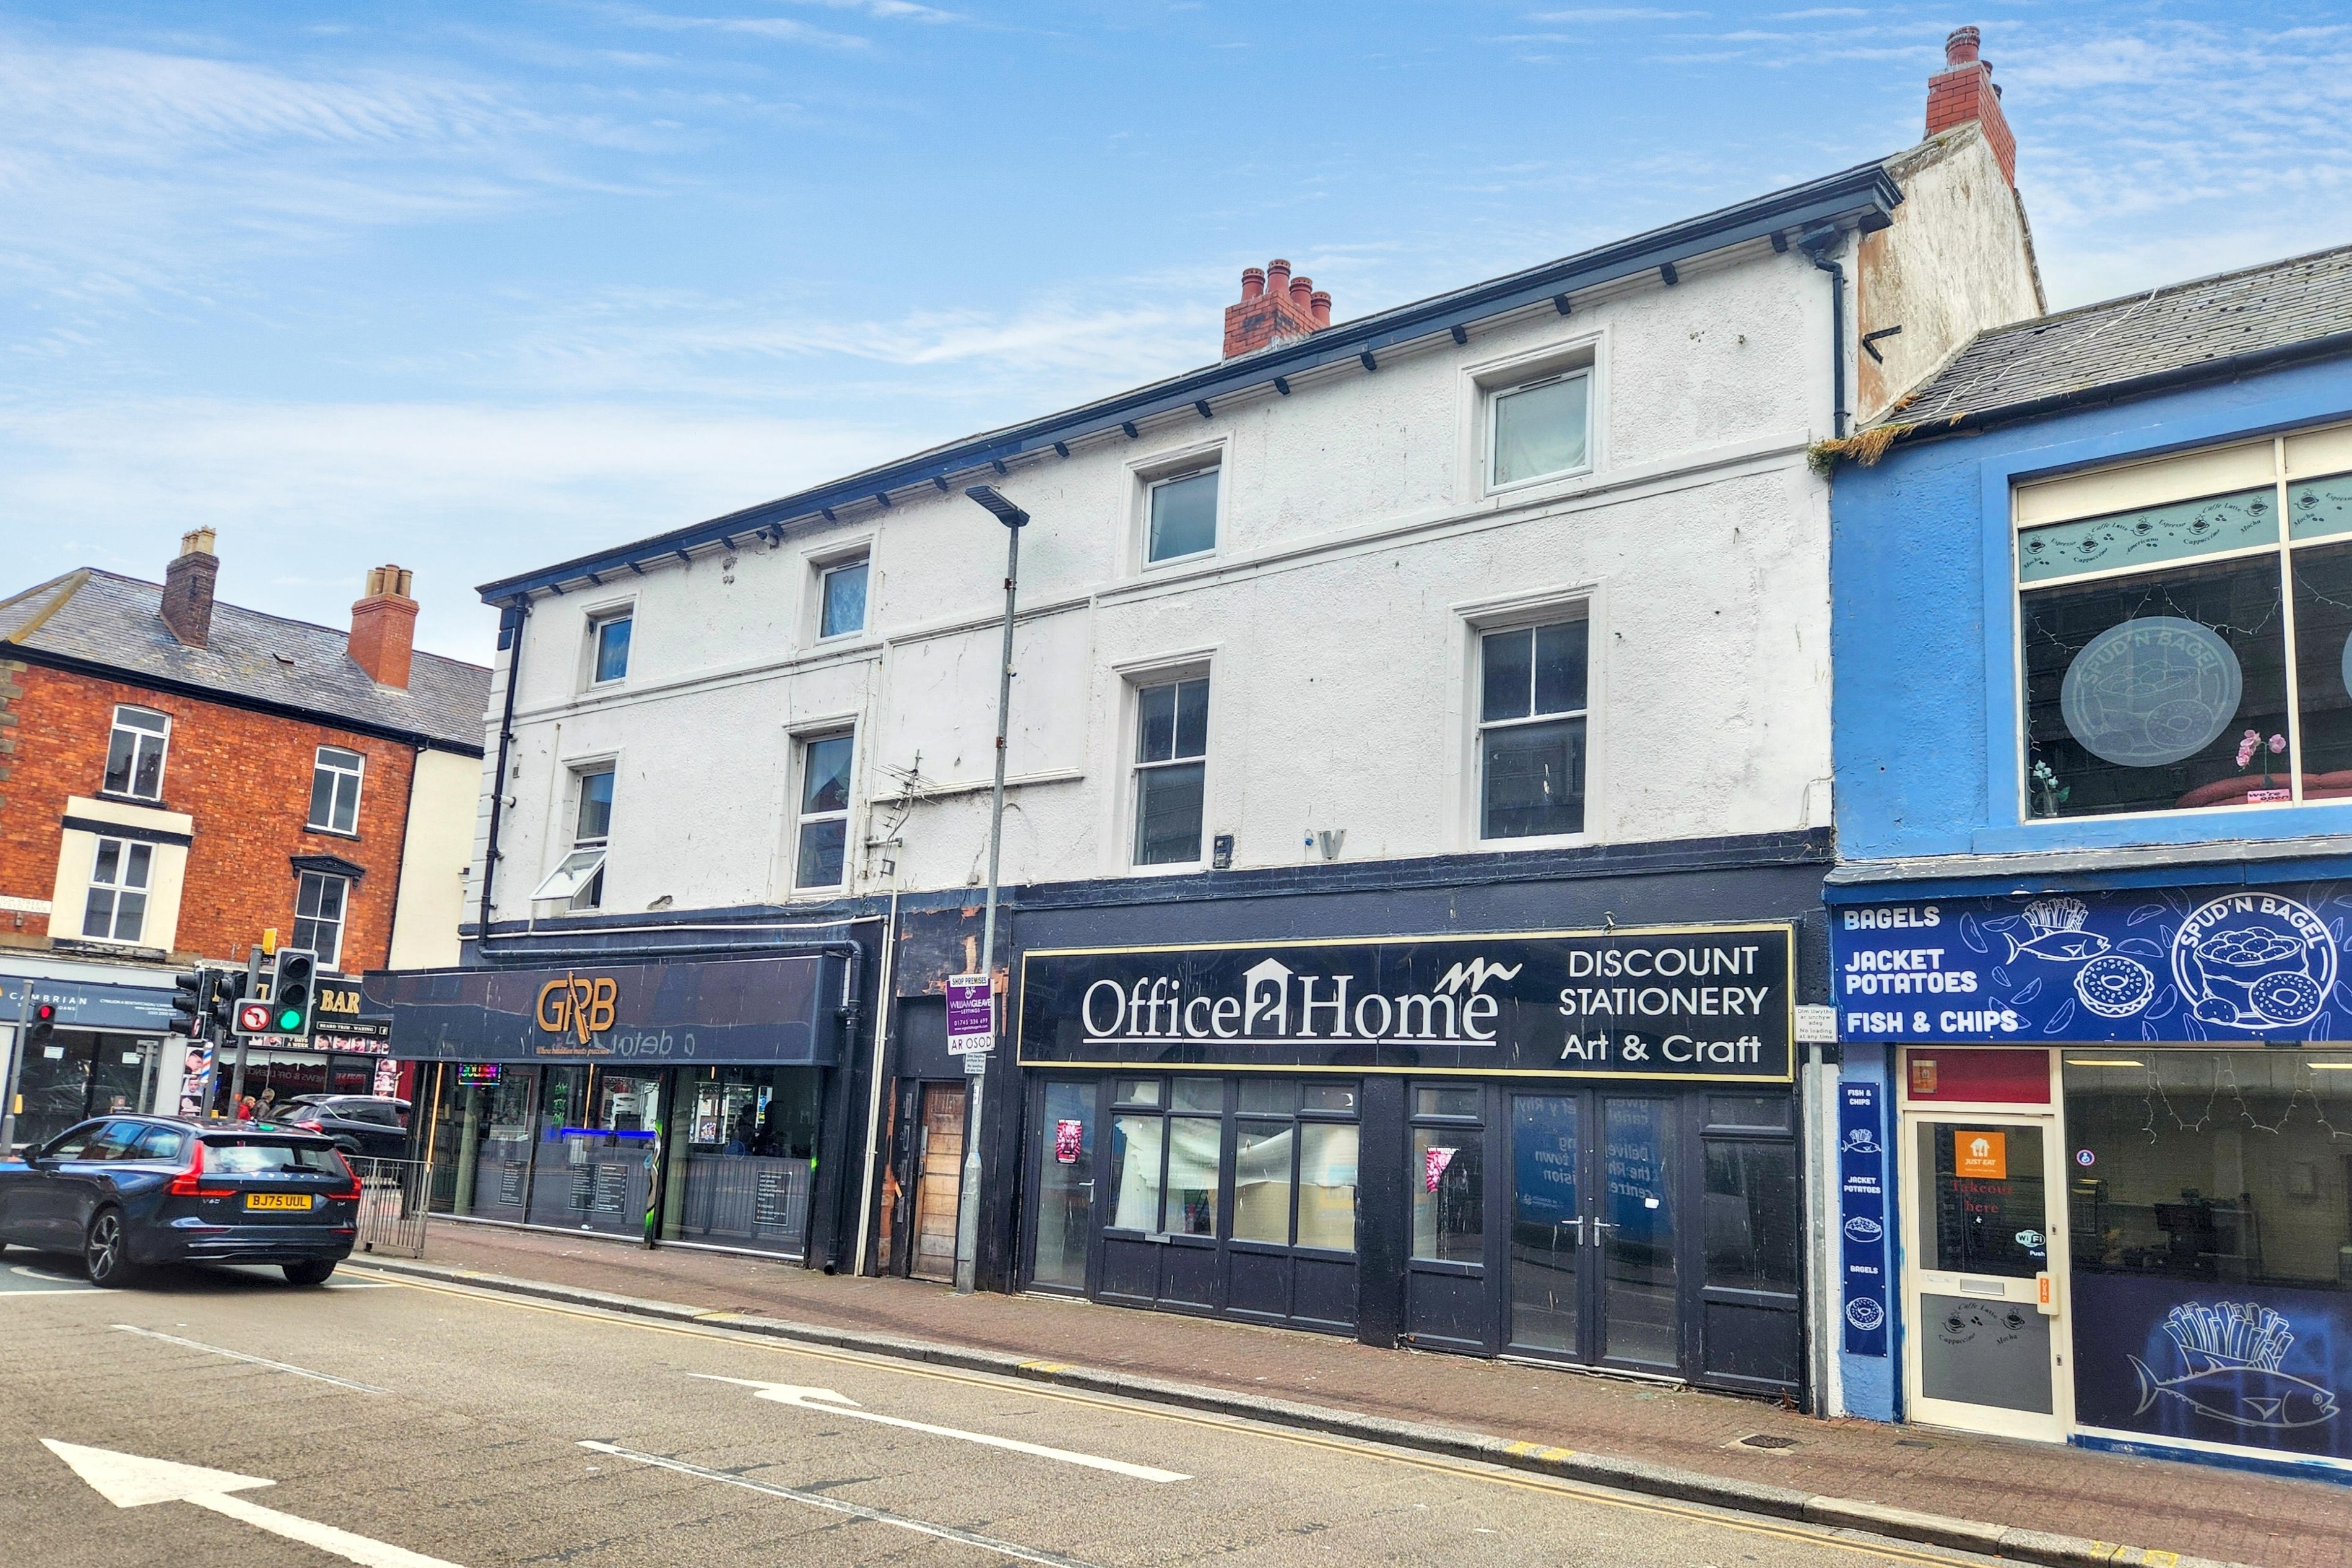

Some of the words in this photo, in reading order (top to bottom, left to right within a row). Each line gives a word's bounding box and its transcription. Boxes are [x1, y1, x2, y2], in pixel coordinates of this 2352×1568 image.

[2159, 519, 2186, 527] Espresso
[2241, 520, 2261, 534] Mocha
[2294, 513, 2315, 527] Mocha
[2050, 537, 2076, 546] Espresso
[2183, 529, 2220, 545] Cappuccino
[2127, 537, 2158, 555] Americano
[2073, 547, 2107, 563] Cappuccino
[2023, 557, 2041, 570] Mocha
[2158, 631, 2219, 675] BAGEL
[1844, 906, 1940, 930] BAGELS
[2260, 898, 2325, 949] BAGEL
[1569, 946, 1760, 977] DISCOUNT
[1844, 948, 1945, 972] JACKET
[965, 977, 987, 985] PREMISES
[1846, 971, 1978, 995] POTATOES
[319, 989, 360, 1014] BAR
[537, 972, 617, 1044] GRB
[1082, 976, 1240, 1038] Office
[1295, 974, 1499, 1040] Home
[1559, 987, 1769, 1016] STATIONERY
[1847, 1011, 1903, 1033] FISH
[1912, 1011, 1931, 1033] &
[1940, 1010, 2018, 1033] CHIPS
[952, 1039, 963, 1050] AR
[966, 1036, 991, 1049] OSOD
[1560, 1034, 1608, 1061] Art
[1623, 1035, 1650, 1062] &
[1662, 1034, 1761, 1063] Craft
[900, 1132, 904, 1141] 2
[1847, 1176, 1877, 1184] JACKET
[1953, 1179, 2013, 1195] Takeout
[1844, 1185, 1881, 1193] POTATOES
[253, 1195, 282, 1206] BJ75
[286, 1196, 306, 1206] UUL
[1964, 1198, 1999, 1213] here
[1850, 1265, 1878, 1274] BAGELS
[1981, 1304, 1998, 1319] Latte
[1938, 1333, 1976, 1345] Cappuccino
[1997, 1333, 2018, 1345] Mocha
